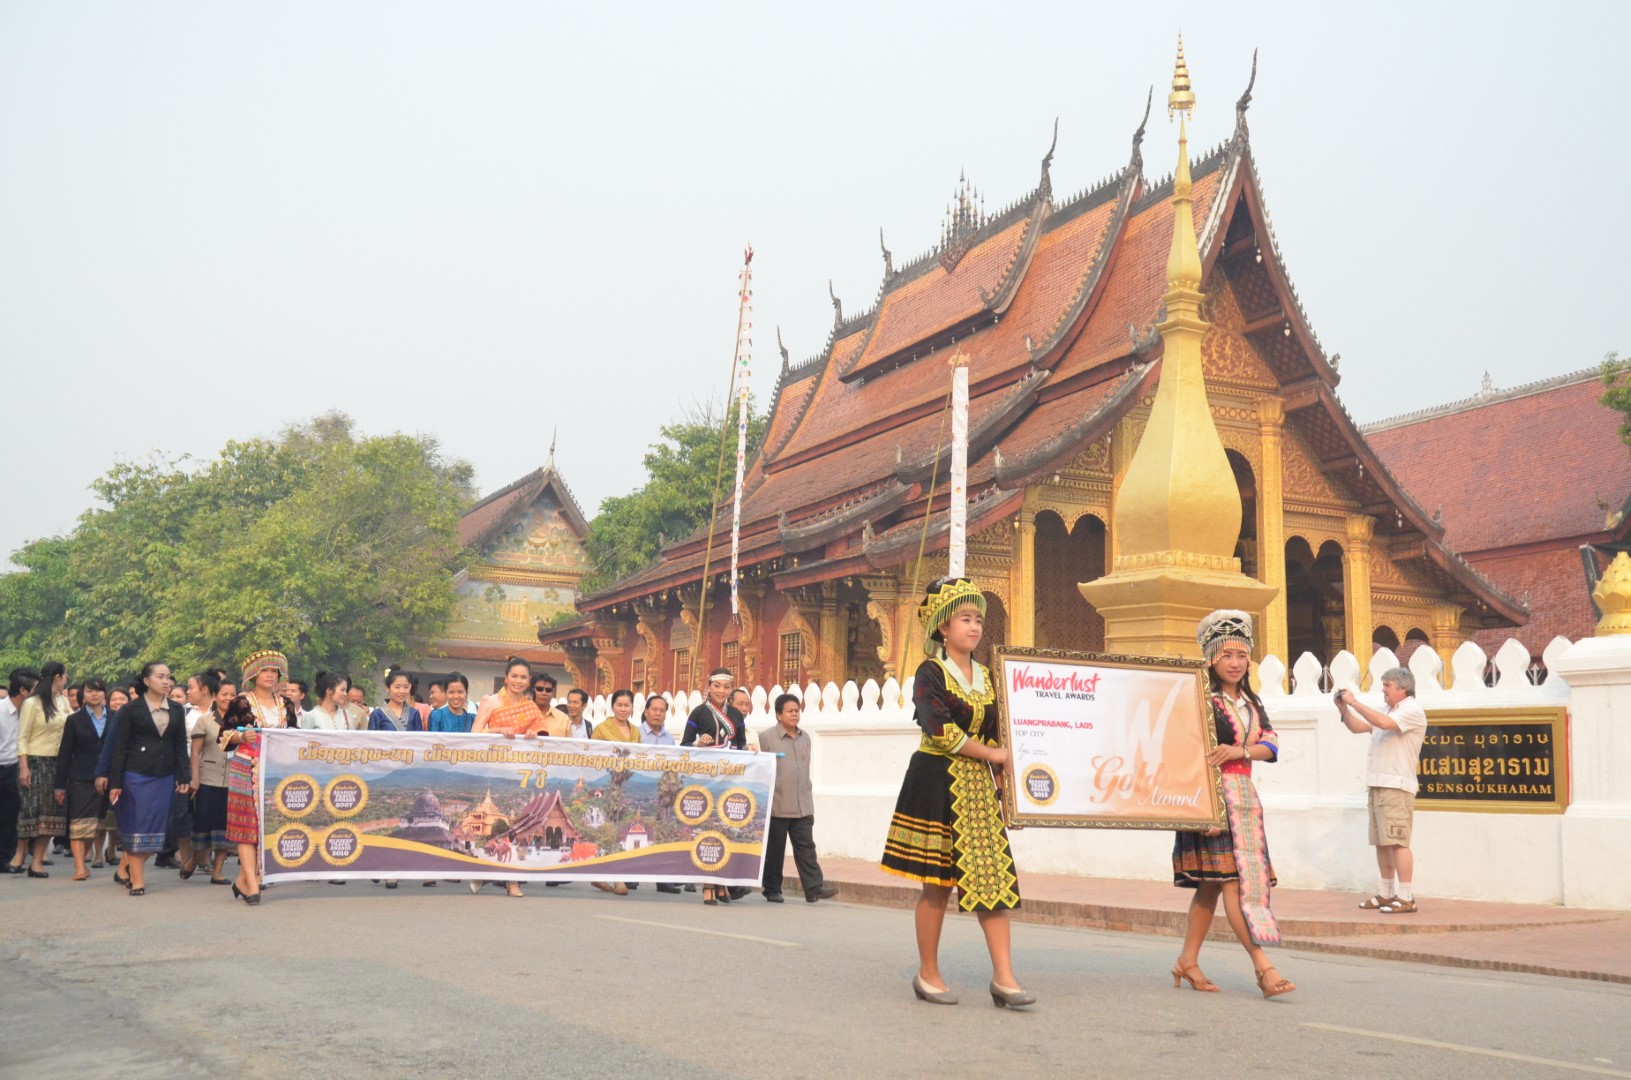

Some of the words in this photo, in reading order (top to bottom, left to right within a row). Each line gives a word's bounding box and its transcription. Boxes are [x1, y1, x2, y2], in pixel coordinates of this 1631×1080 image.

[1013, 665, 1101, 693] Wanderlust
[1035, 691, 1062, 700] TRAVEL
[1065, 692, 1095, 701] AWARDS
[1013, 718, 1073, 729] LUANGPRABANG,
[1075, 721, 1094, 730] LAOS
[1015, 729, 1028, 737] TOP
[1030, 730, 1045, 738] CITY
[517, 769, 532, 789] 7
[1090, 755, 1165, 804] Gold
[1138, 786, 1202, 807] Award
[1427, 783, 1552, 795] SENSOUKHARAM
